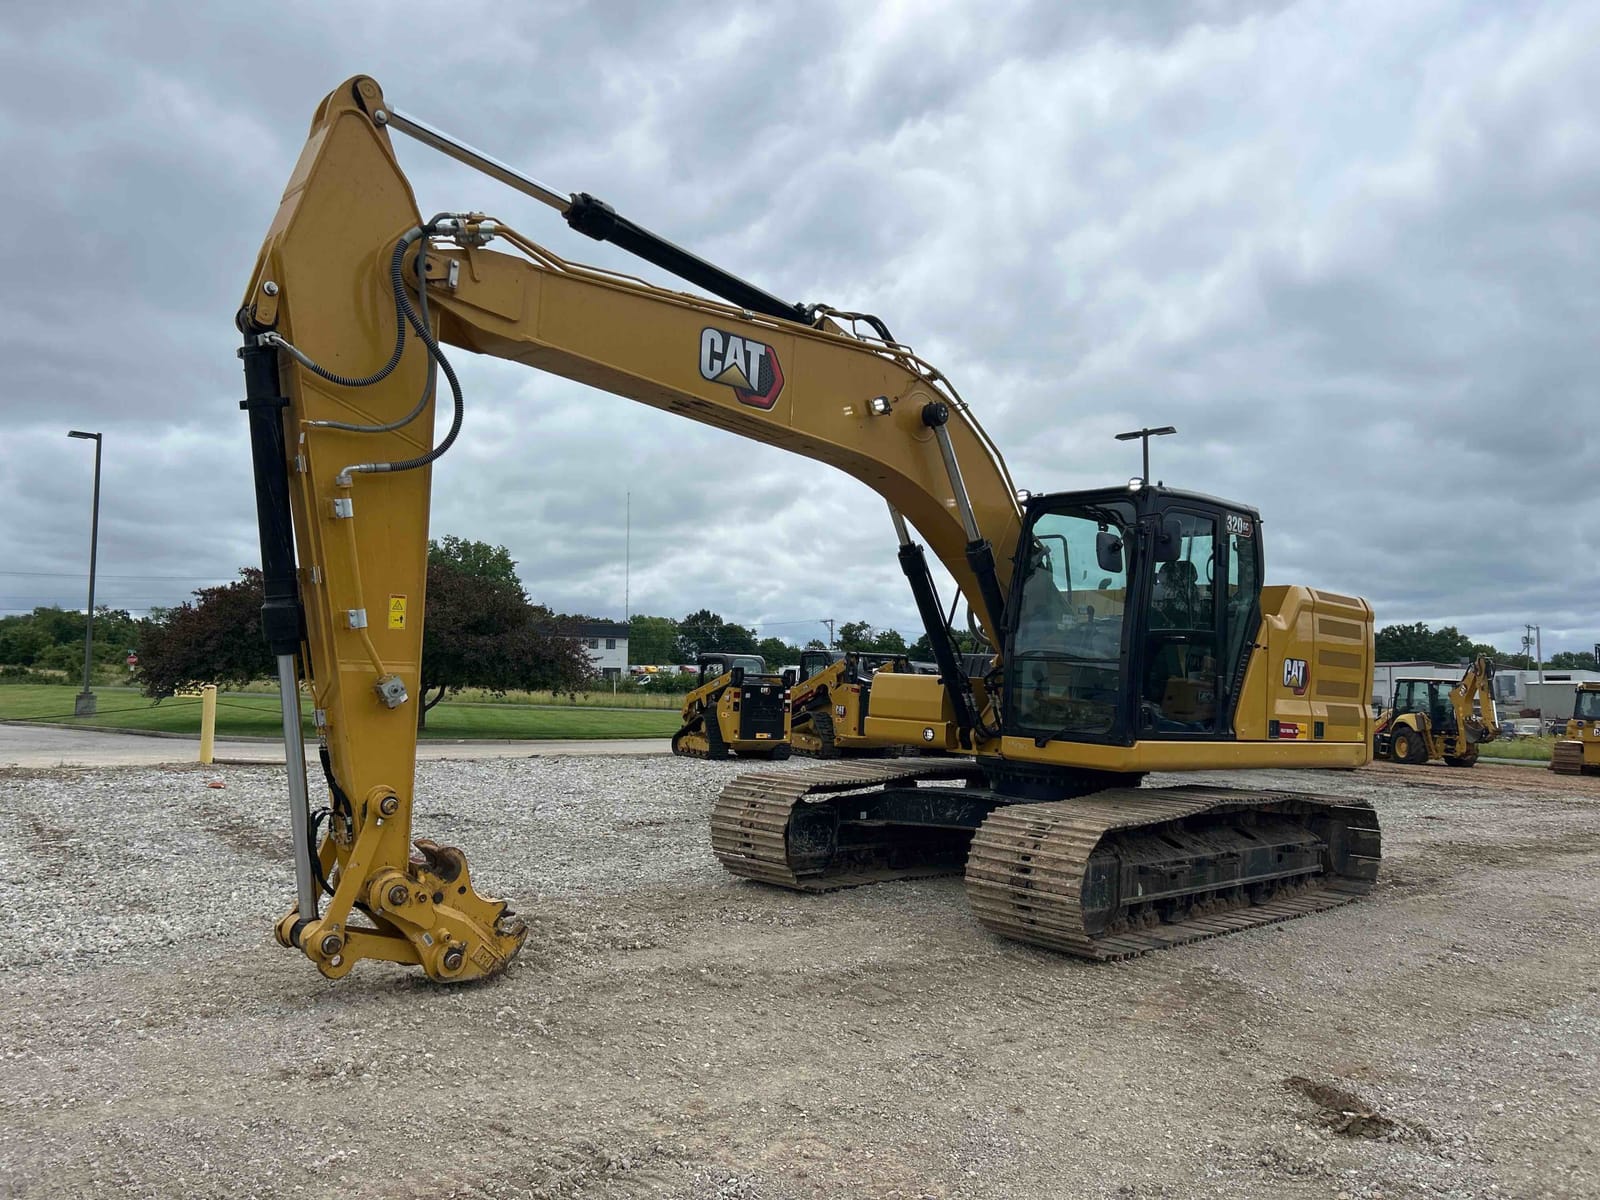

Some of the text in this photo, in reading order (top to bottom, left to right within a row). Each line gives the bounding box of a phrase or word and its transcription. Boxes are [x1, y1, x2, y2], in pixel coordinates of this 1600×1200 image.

[701, 327, 766, 391] CAT
[1226, 514, 1243, 534] 320
[1283, 659, 1305, 688] CAT
[835, 704, 845, 715] CAT
